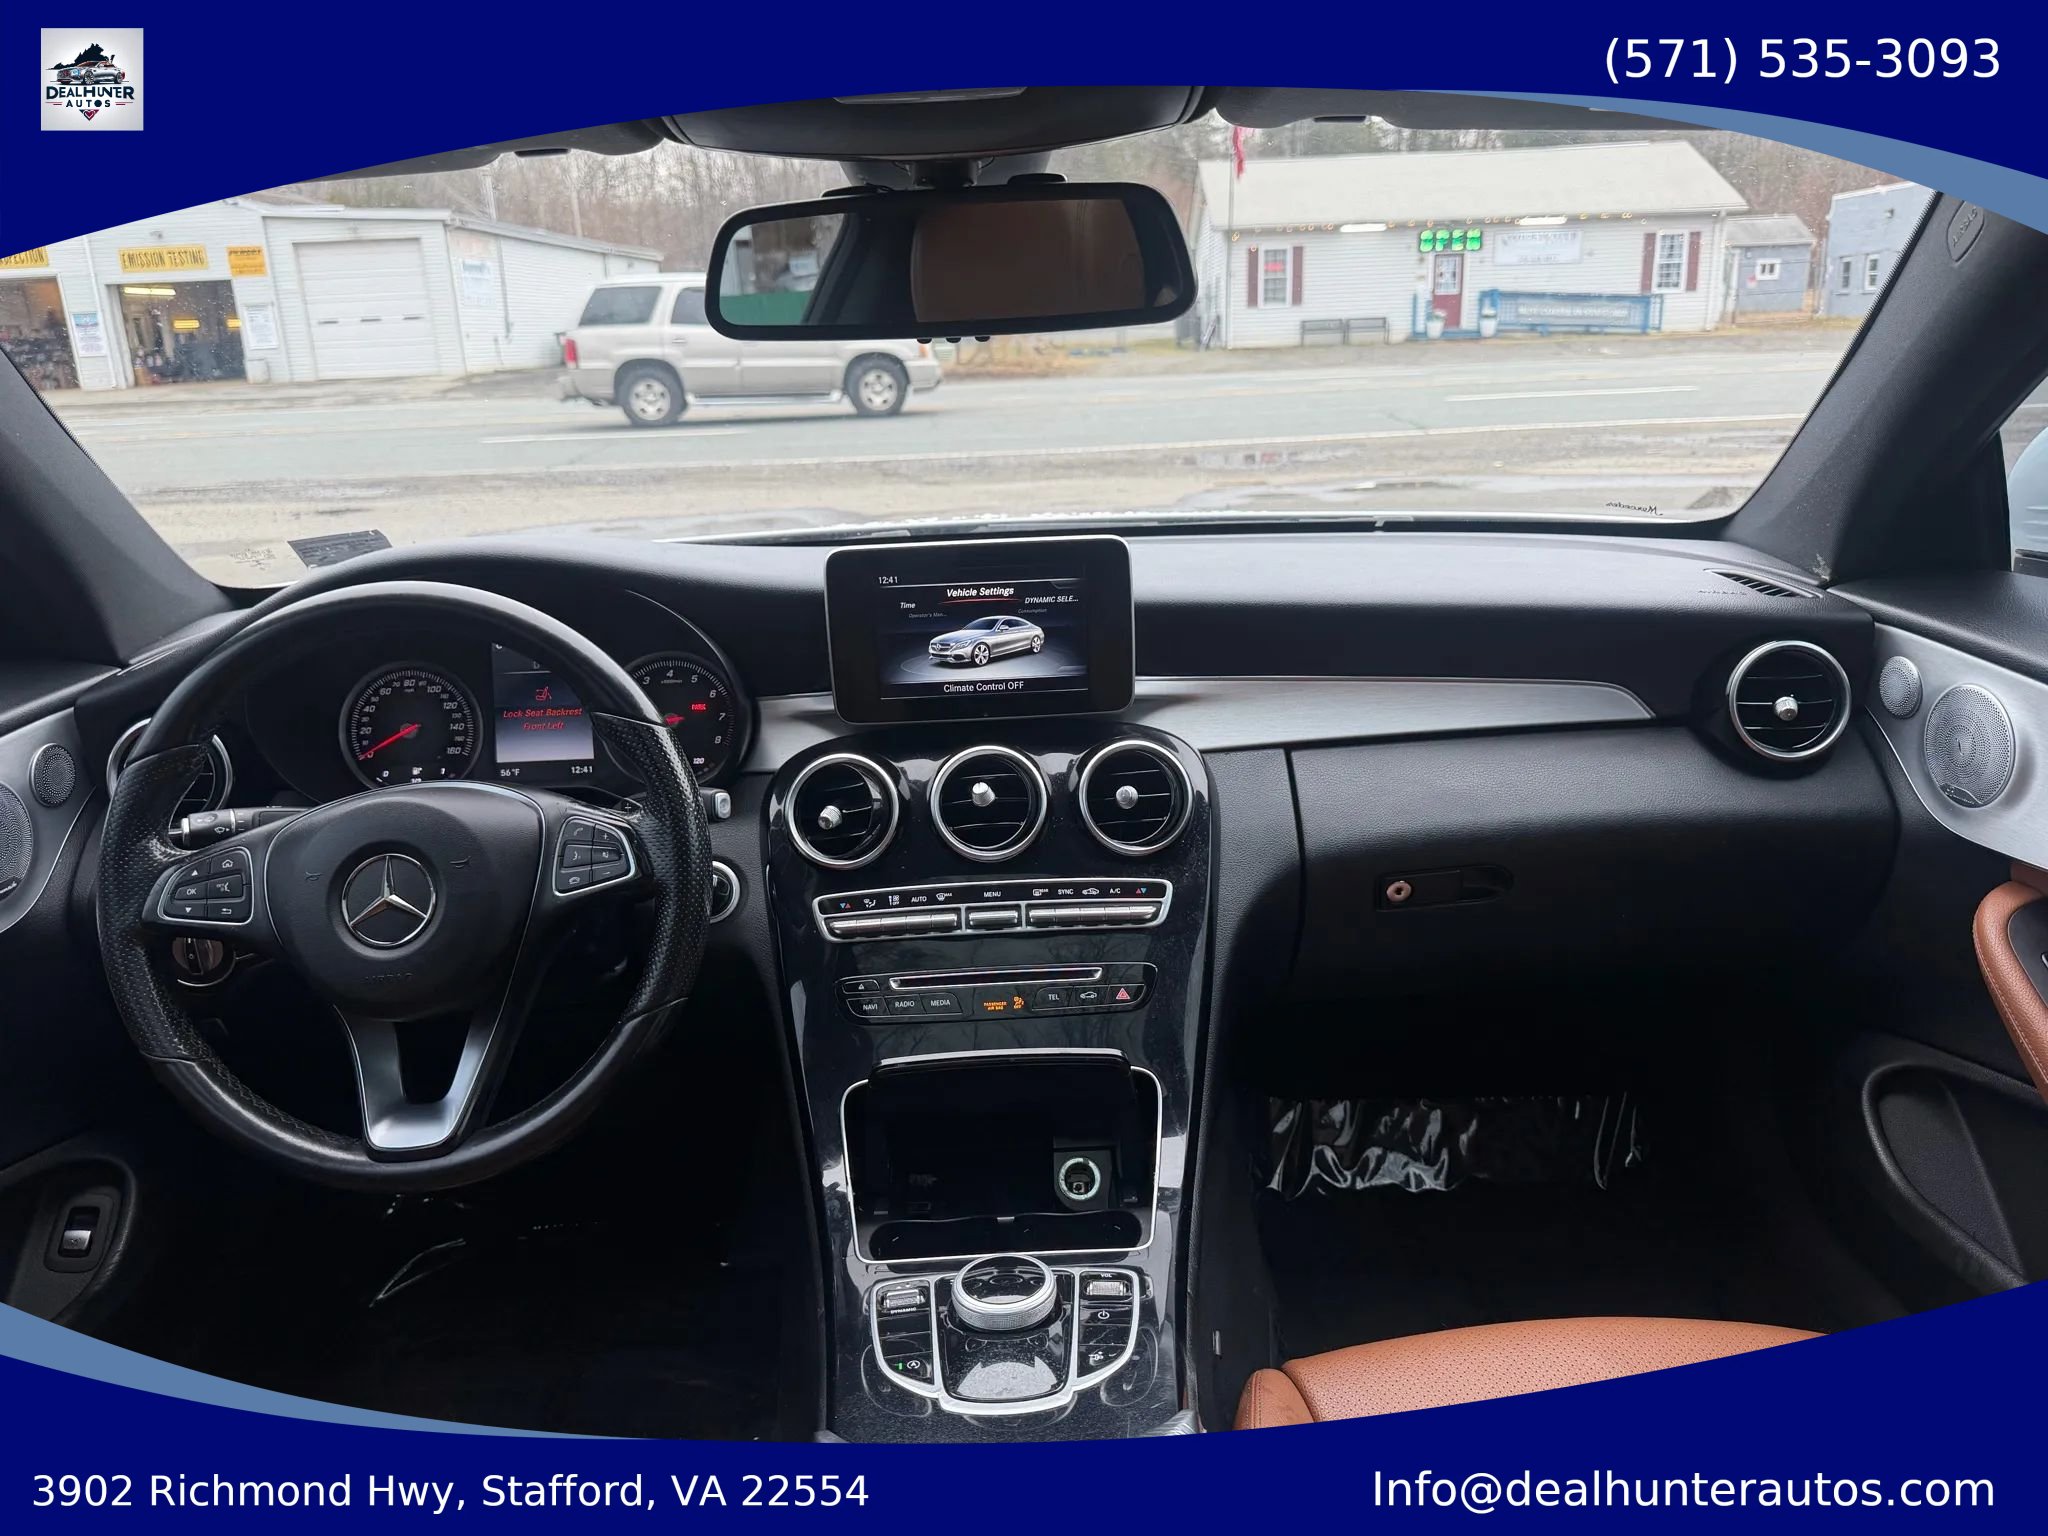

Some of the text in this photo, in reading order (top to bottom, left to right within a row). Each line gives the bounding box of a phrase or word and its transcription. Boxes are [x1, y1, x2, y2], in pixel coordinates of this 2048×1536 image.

[122, 249, 205, 269] EMISSION TESTING
[878, 576, 898, 585] 12:41
[946, 587, 1014, 597] Vehicle Settings
[1025, 596, 1056, 604] DYNAMIC
[666, 669, 674, 678] 4
[403, 679, 416, 687] 80
[642, 676, 650, 685] 3
[691, 674, 698, 683] 5
[943, 681, 1024, 692] Climate Control OFF
[709, 689, 717, 698] 6
[363, 705, 376, 713] 40
[503, 708, 582, 718] Lock Seat Backrest
[719, 712, 726, 721] 7
[523, 722, 564, 730] Front Left
[714, 735, 722, 744] 8
[693, 757, 705, 765] 120
[571, 766, 593, 774] 12:41
[186, 888, 197, 896] OK
[862, 1003, 878, 1011] NAVI
[895, 1000, 915, 1008] RADIO
[930, 999, 951, 1007] MEDIA
